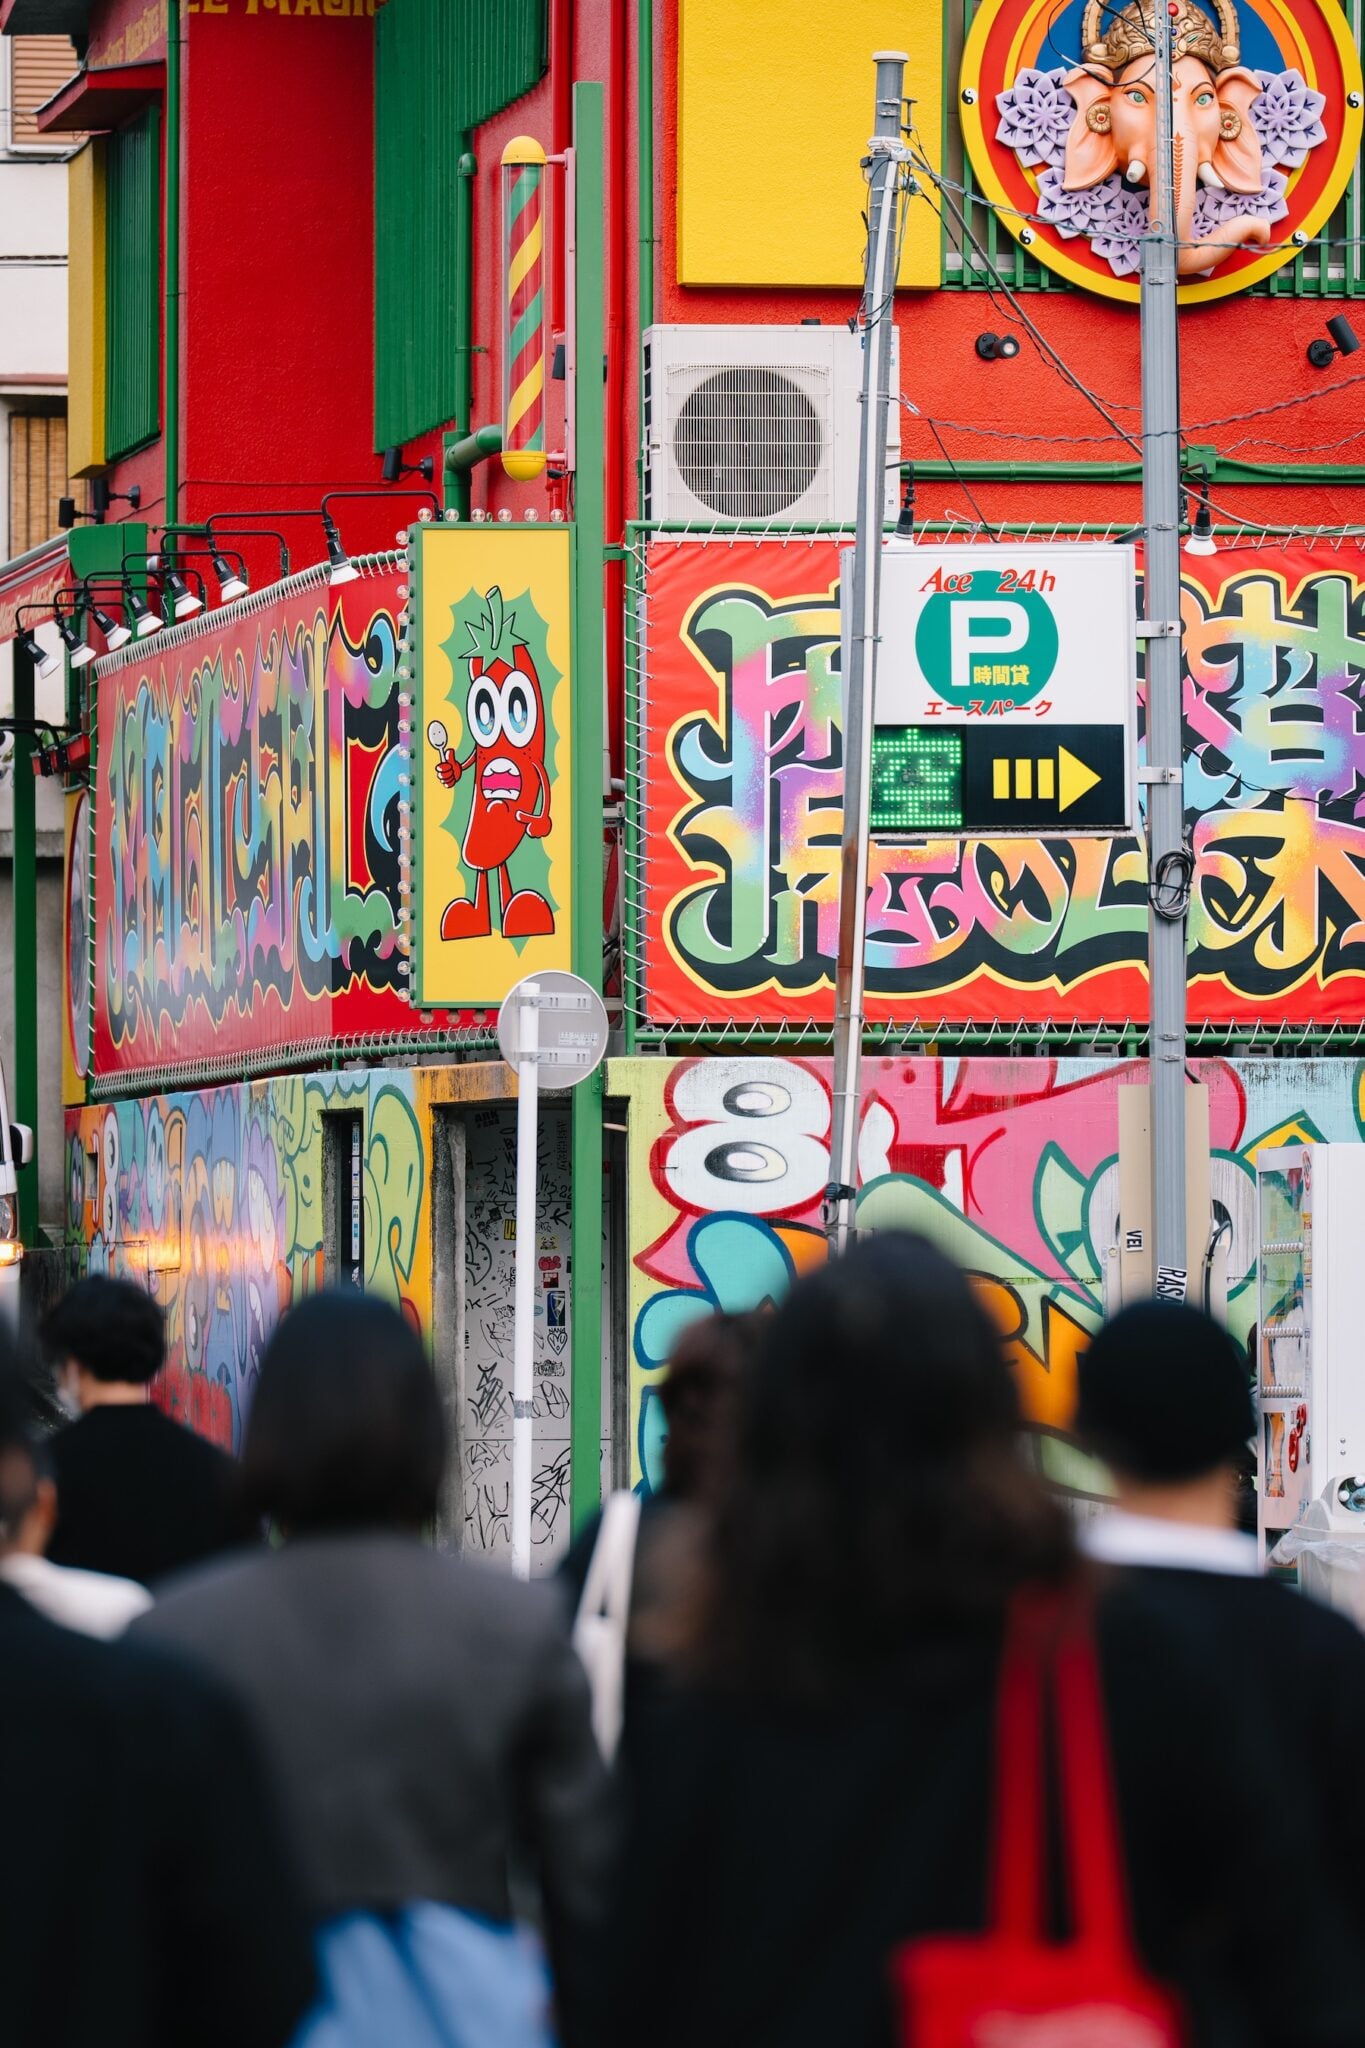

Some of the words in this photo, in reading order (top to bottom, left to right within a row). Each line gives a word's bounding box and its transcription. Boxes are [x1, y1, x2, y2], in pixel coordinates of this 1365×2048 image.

[919, 566, 973, 593] Ace
[997, 569, 1056, 592] 24h
[951, 600, 1030, 686] P
[973, 665, 1030, 686] 時間貸
[924, 699, 1053, 717] エースパーク
[870, 728, 962, 826] 空
